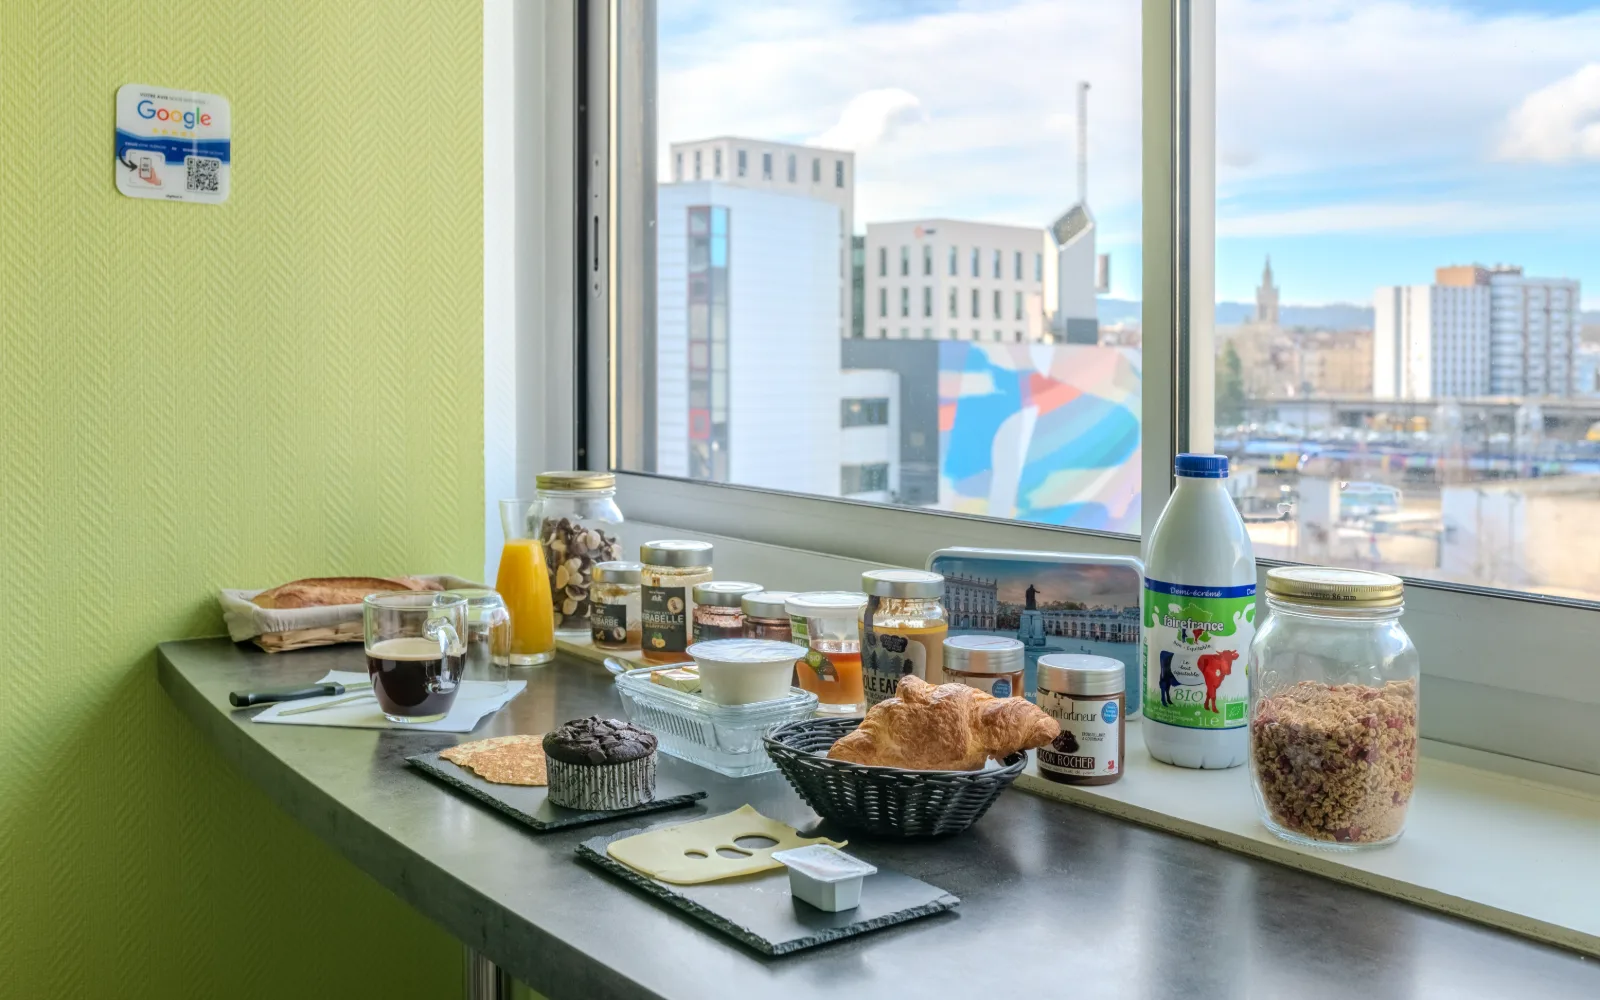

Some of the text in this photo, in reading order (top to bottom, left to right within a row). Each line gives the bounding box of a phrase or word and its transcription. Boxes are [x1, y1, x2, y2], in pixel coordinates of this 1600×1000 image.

[137, 100, 211, 129] Google
[1169, 587, 1222, 599] Demi-écrémé
[1332, 592, 1341, 600] 86
[642, 613, 684, 624] IRABELLE
[863, 675, 877, 692] OLE
[879, 678, 899, 695] EAR
[1174, 688, 1204, 703] BIO
[1057, 755, 1094, 768] ROCHER
